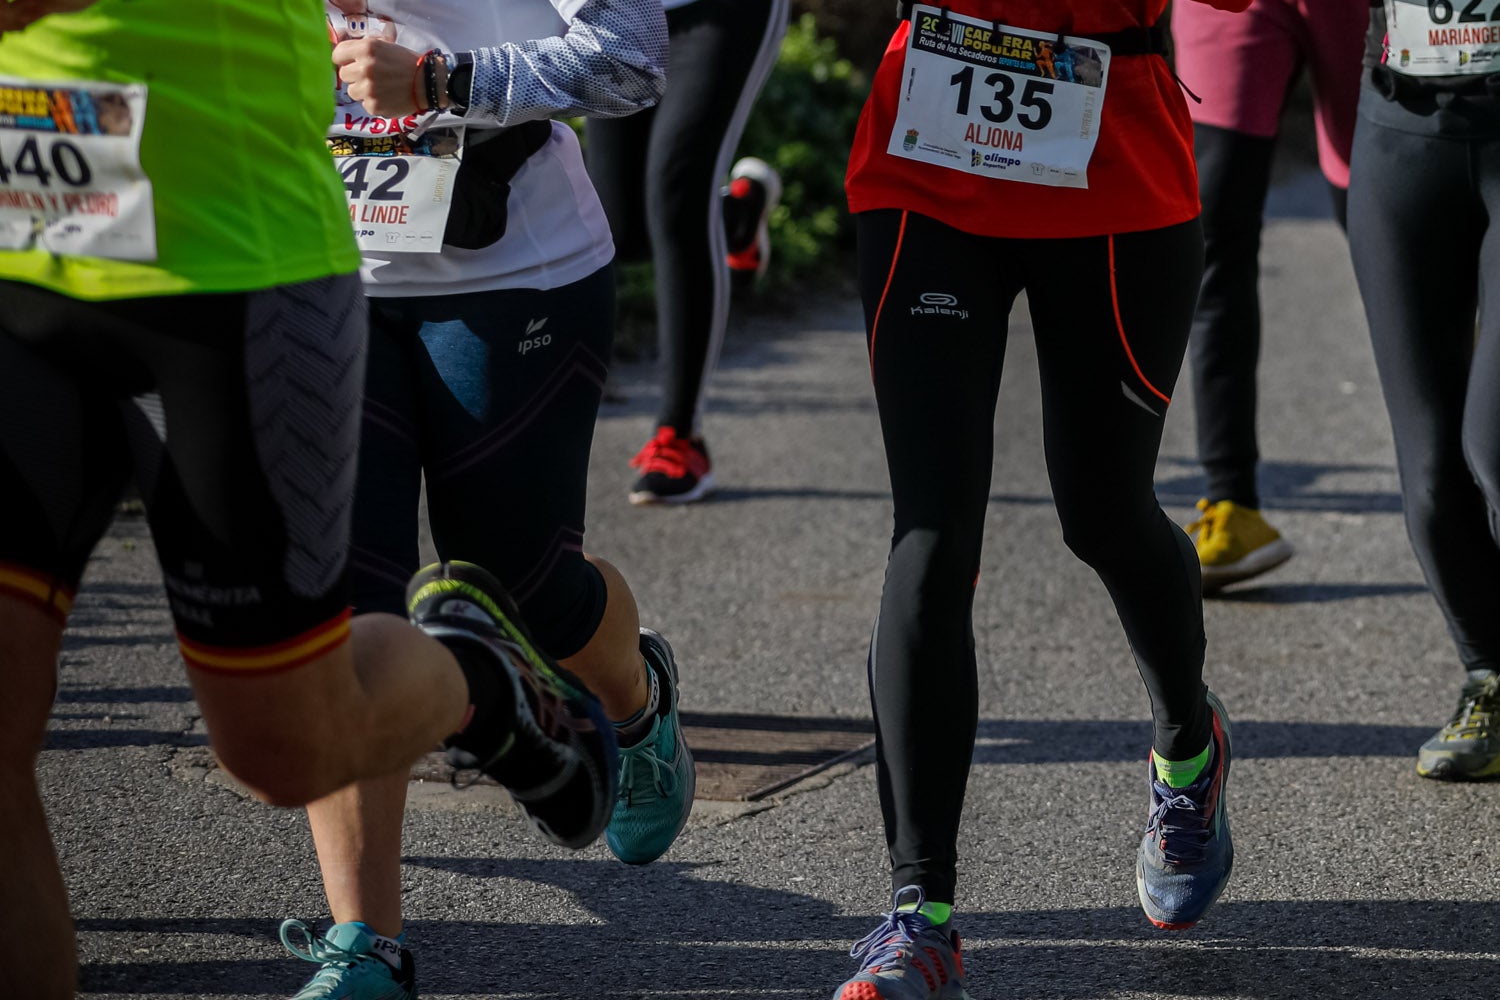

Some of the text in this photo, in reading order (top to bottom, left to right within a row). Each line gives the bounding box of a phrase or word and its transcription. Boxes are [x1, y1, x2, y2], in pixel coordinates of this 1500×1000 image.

[950, 22, 966, 45] VII
[964, 26, 1034, 51] CARERA
[918, 36, 937, 48] Ruta
[936, 41, 946, 51] de
[946, 43, 958, 54] los
[958, 47, 998, 64] Secaderos
[962, 37, 1033, 60] POPULAR
[949, 65, 1056, 131] 135
[344, 112, 419, 135] VIDAS
[963, 122, 1024, 152] ALJONA
[984, 153, 1022, 167] olimpo
[339, 157, 410, 201] 42
[360, 205, 410, 225] LINDE
[910, 305, 969, 320] Kalenji
